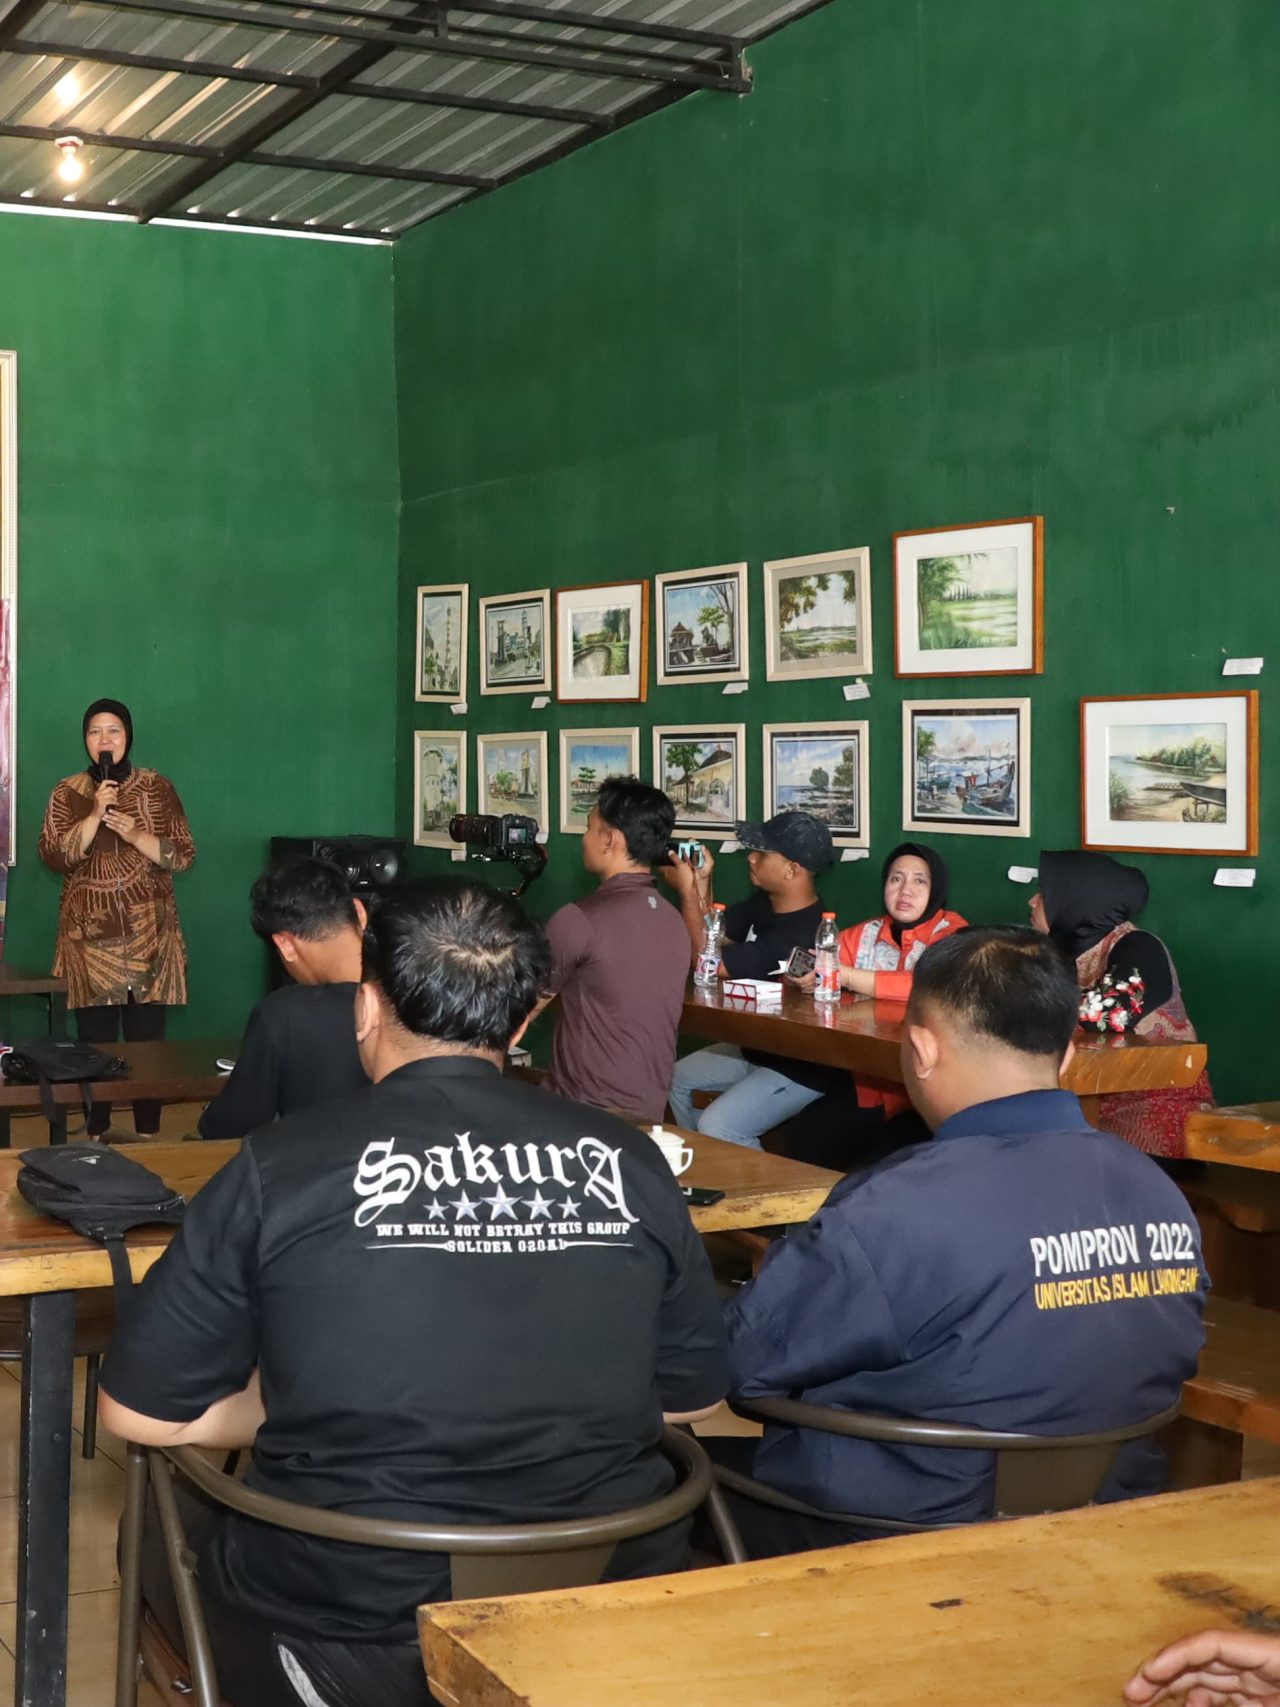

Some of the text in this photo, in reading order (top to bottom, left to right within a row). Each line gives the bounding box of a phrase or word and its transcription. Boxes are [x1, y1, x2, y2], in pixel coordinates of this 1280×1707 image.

[376, 1221, 631, 1237] WE WILL NOT BETRAY THIS GROUP
[1029, 1222, 1195, 1278] POMPROV 2022
[1034, 1275, 1112, 1310] UNIVERSITAS
[1111, 1270, 1149, 1301] ISLAM
